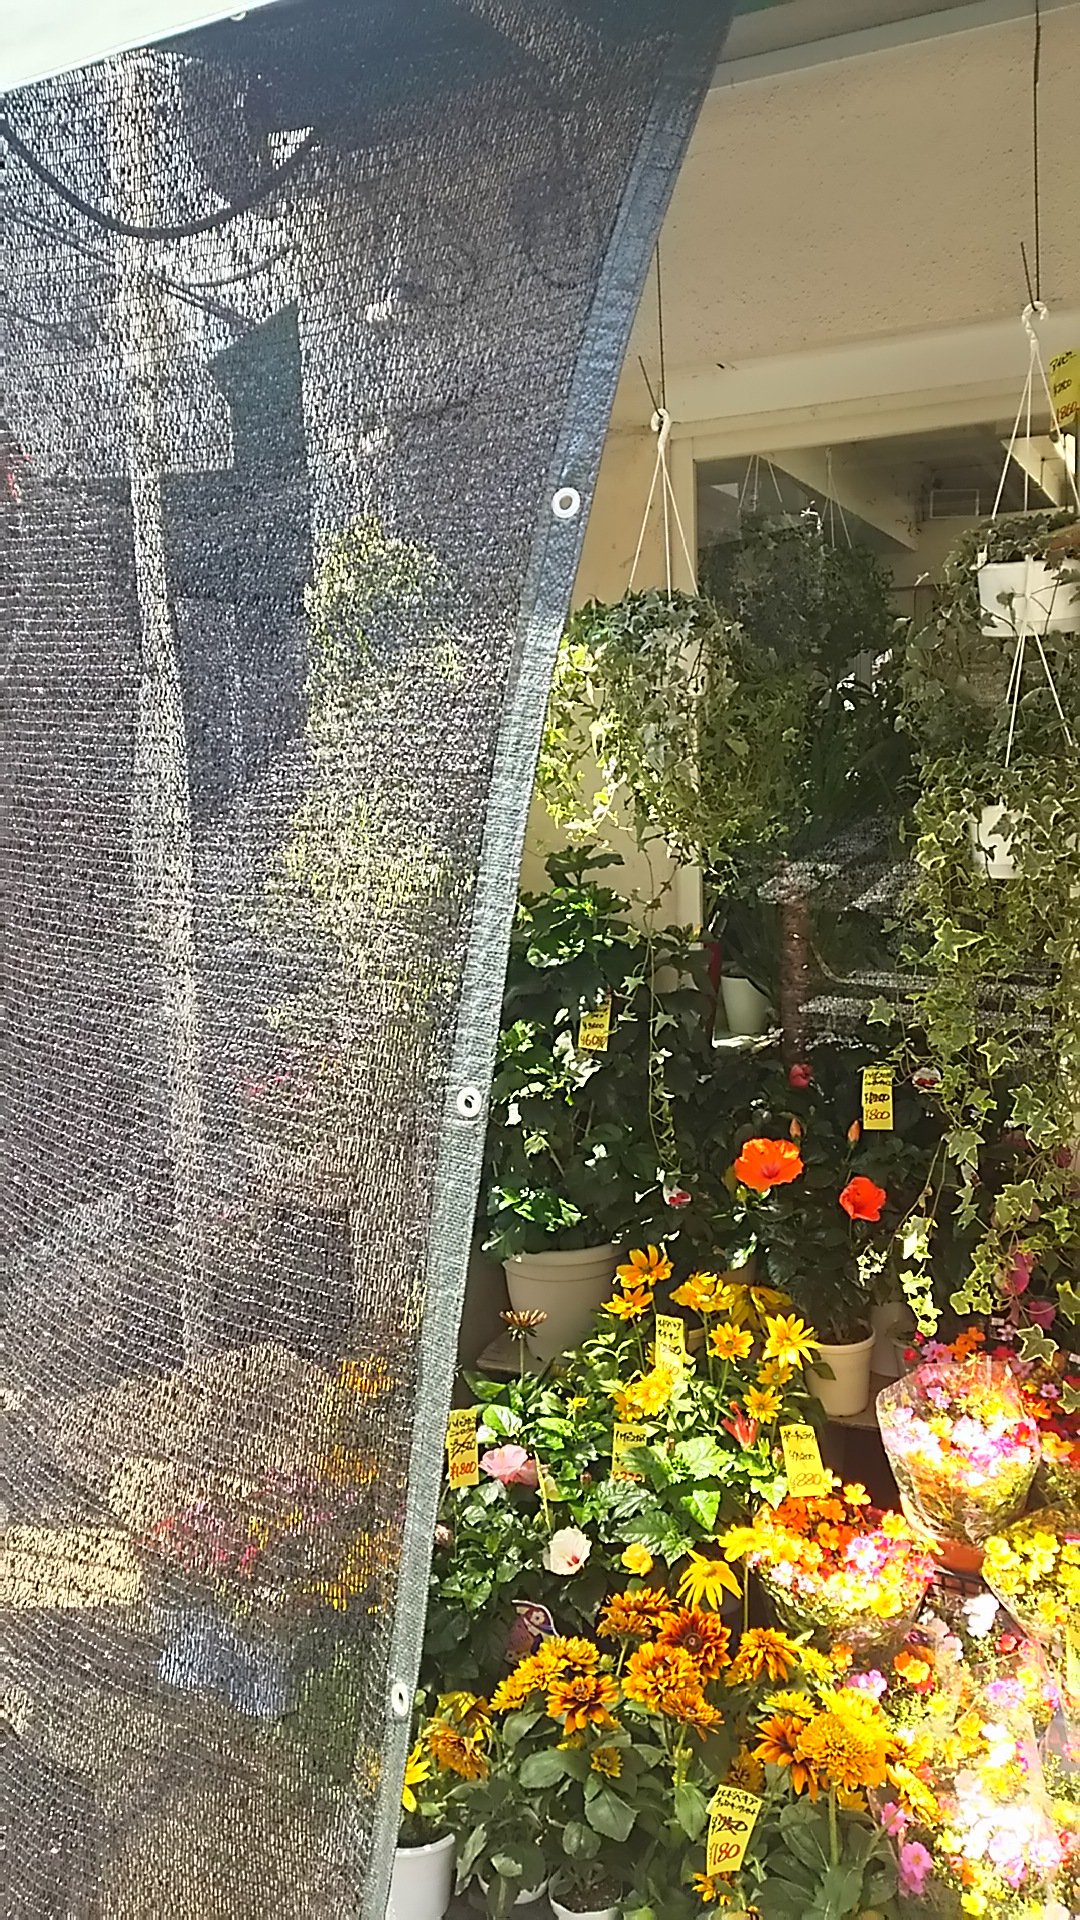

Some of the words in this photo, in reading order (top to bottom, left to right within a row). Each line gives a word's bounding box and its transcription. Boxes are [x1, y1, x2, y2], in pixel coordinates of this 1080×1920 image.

[865, 1109, 890, 1121] ¥800
[790, 1473, 822, 1492] ¥880
[717, 1789, 758, 1805] ルドベキア
[709, 1842, 741, 1866] ¥180
